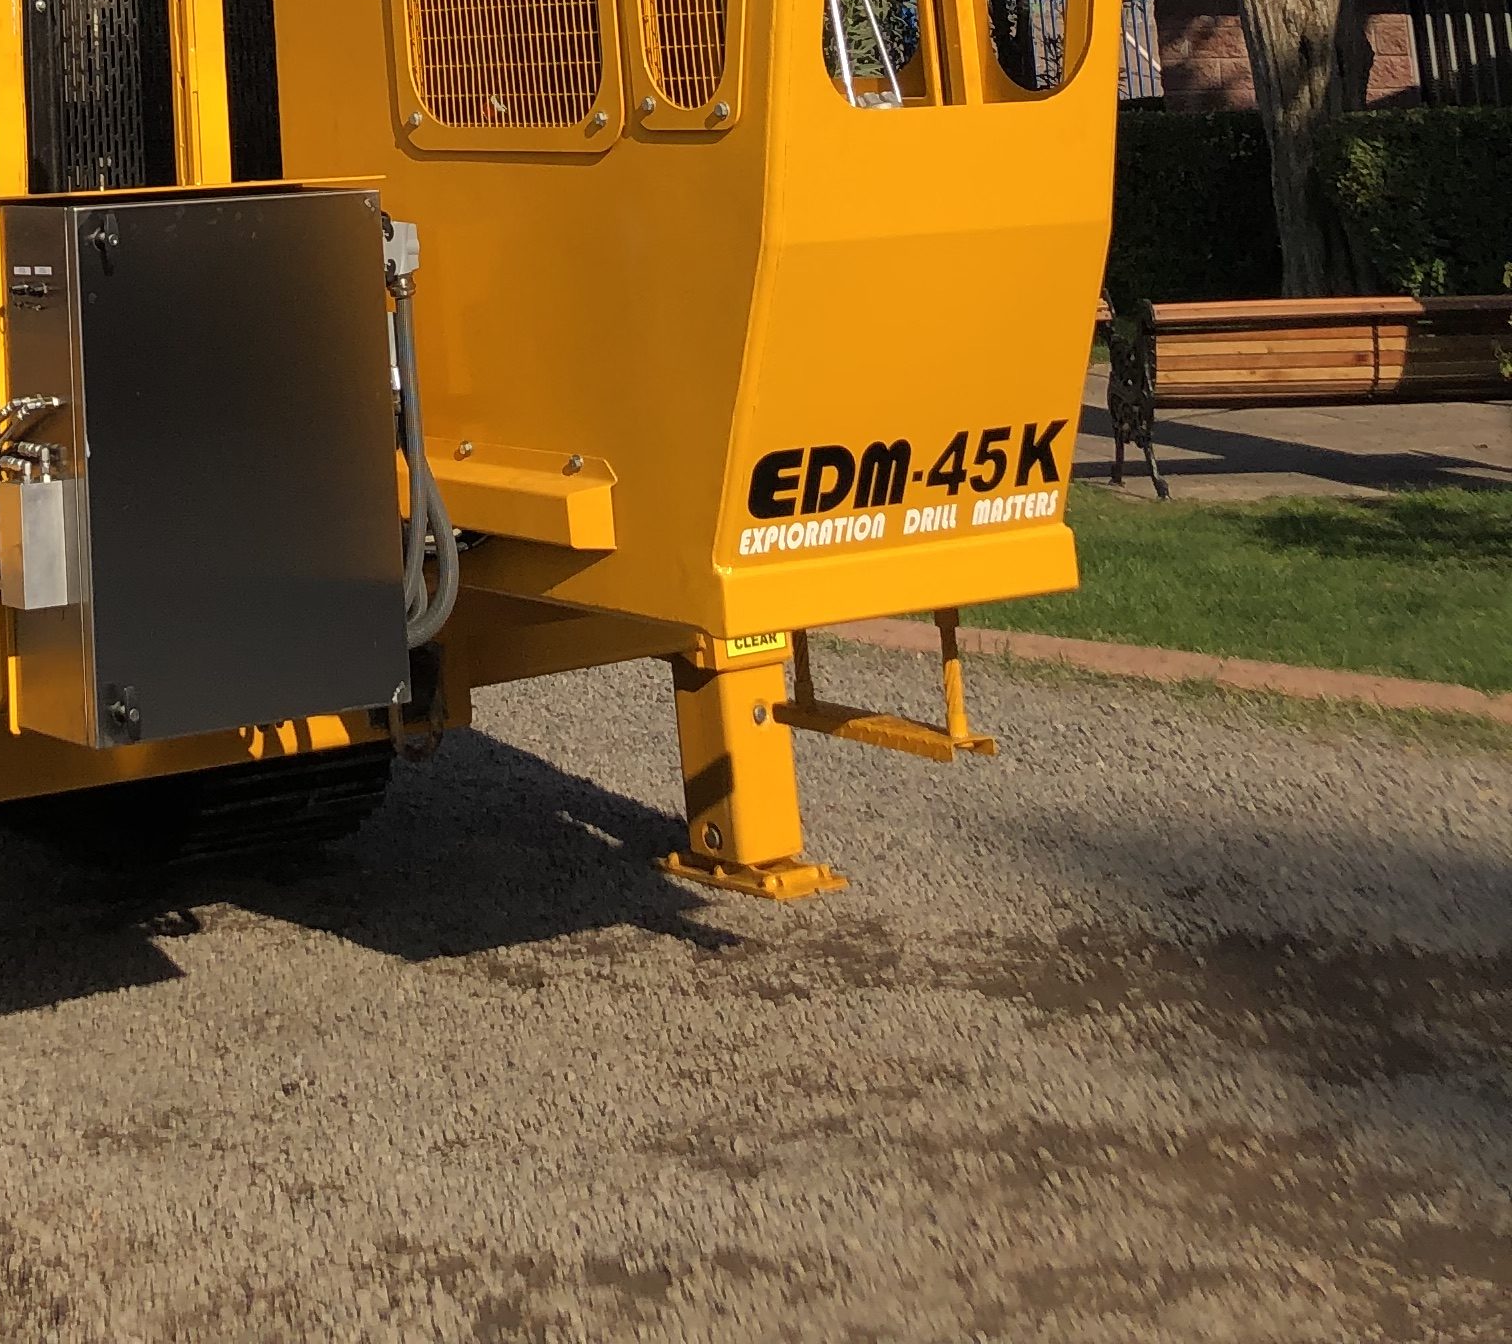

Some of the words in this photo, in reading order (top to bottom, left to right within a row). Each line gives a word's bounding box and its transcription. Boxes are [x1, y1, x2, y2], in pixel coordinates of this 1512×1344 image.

[739, 512, 886, 555] EXPLORATION
[903, 504, 958, 535] DRILL
[972, 490, 1059, 526] MASTERS
